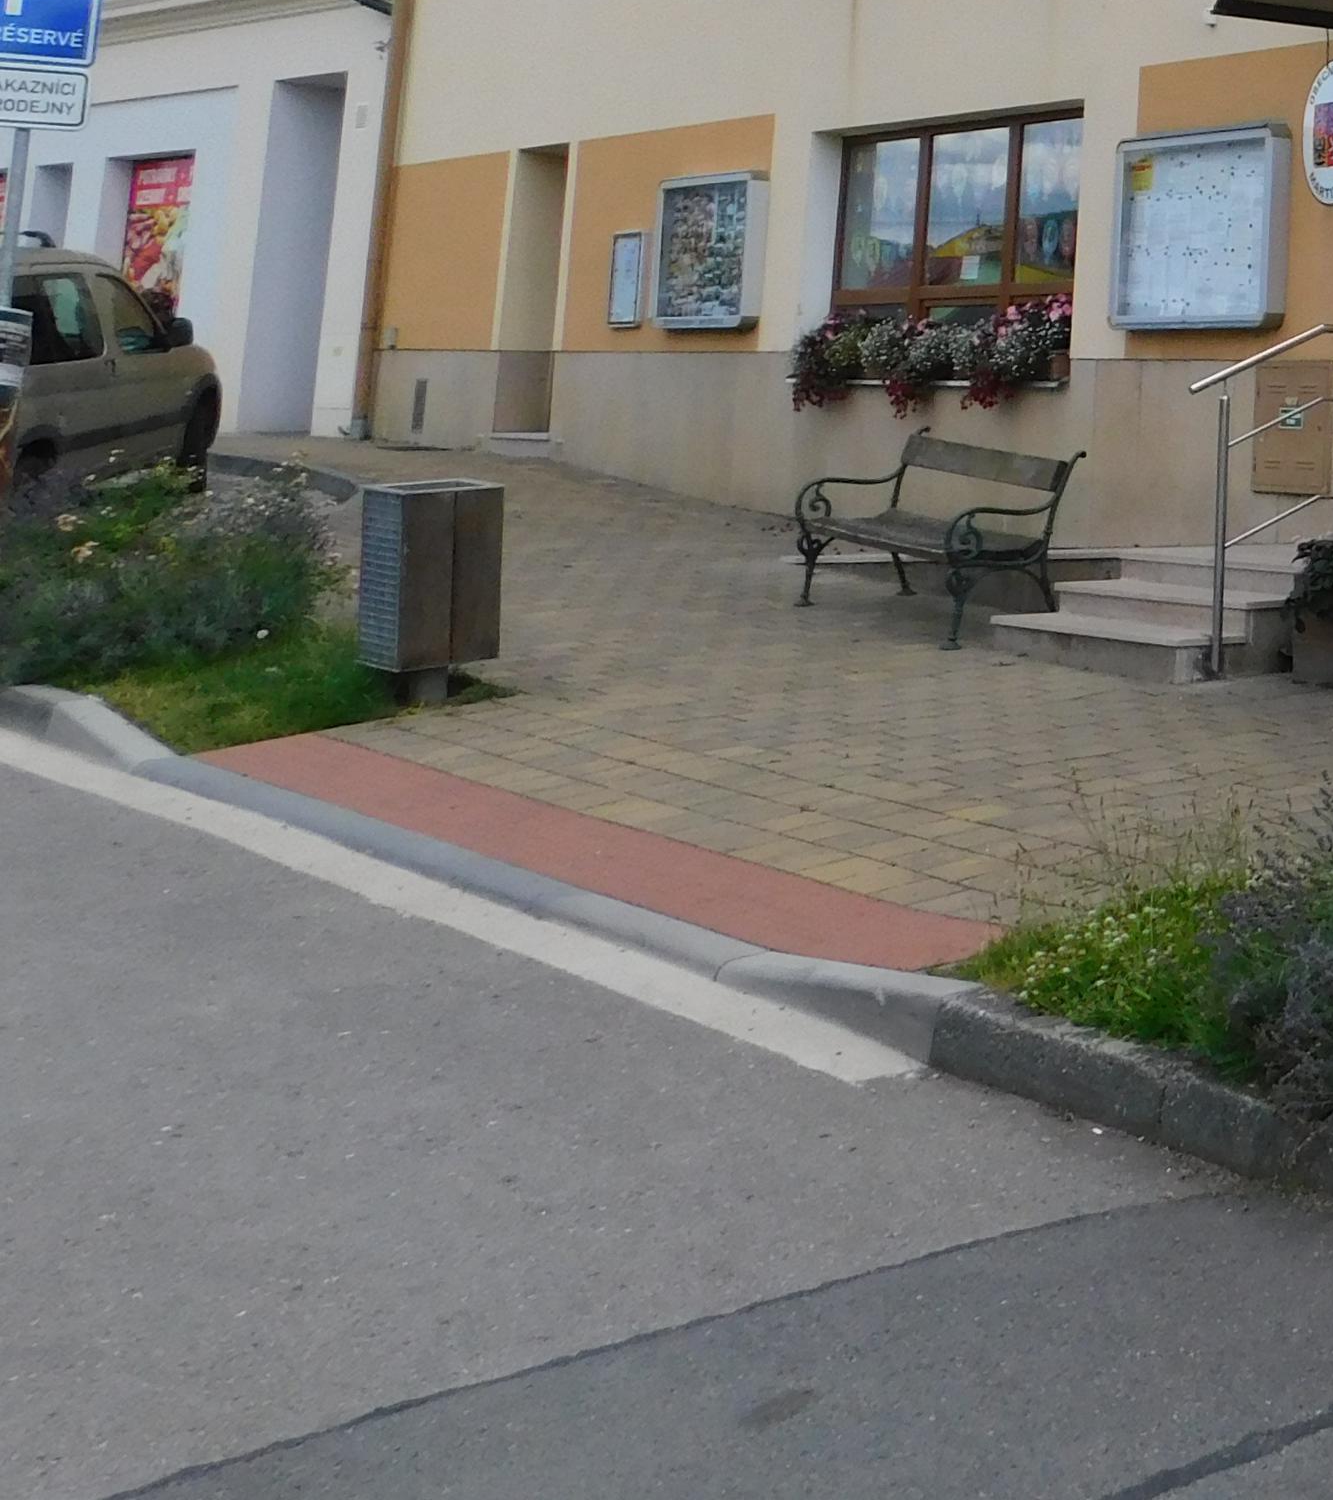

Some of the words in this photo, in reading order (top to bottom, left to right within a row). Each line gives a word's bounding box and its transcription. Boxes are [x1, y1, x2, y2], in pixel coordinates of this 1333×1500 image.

[0, 22, 84, 48] ÉSERVÉ
[0, 77, 77, 96] KAZNÍCI
[0, 98, 75, 116] ODEJNY
